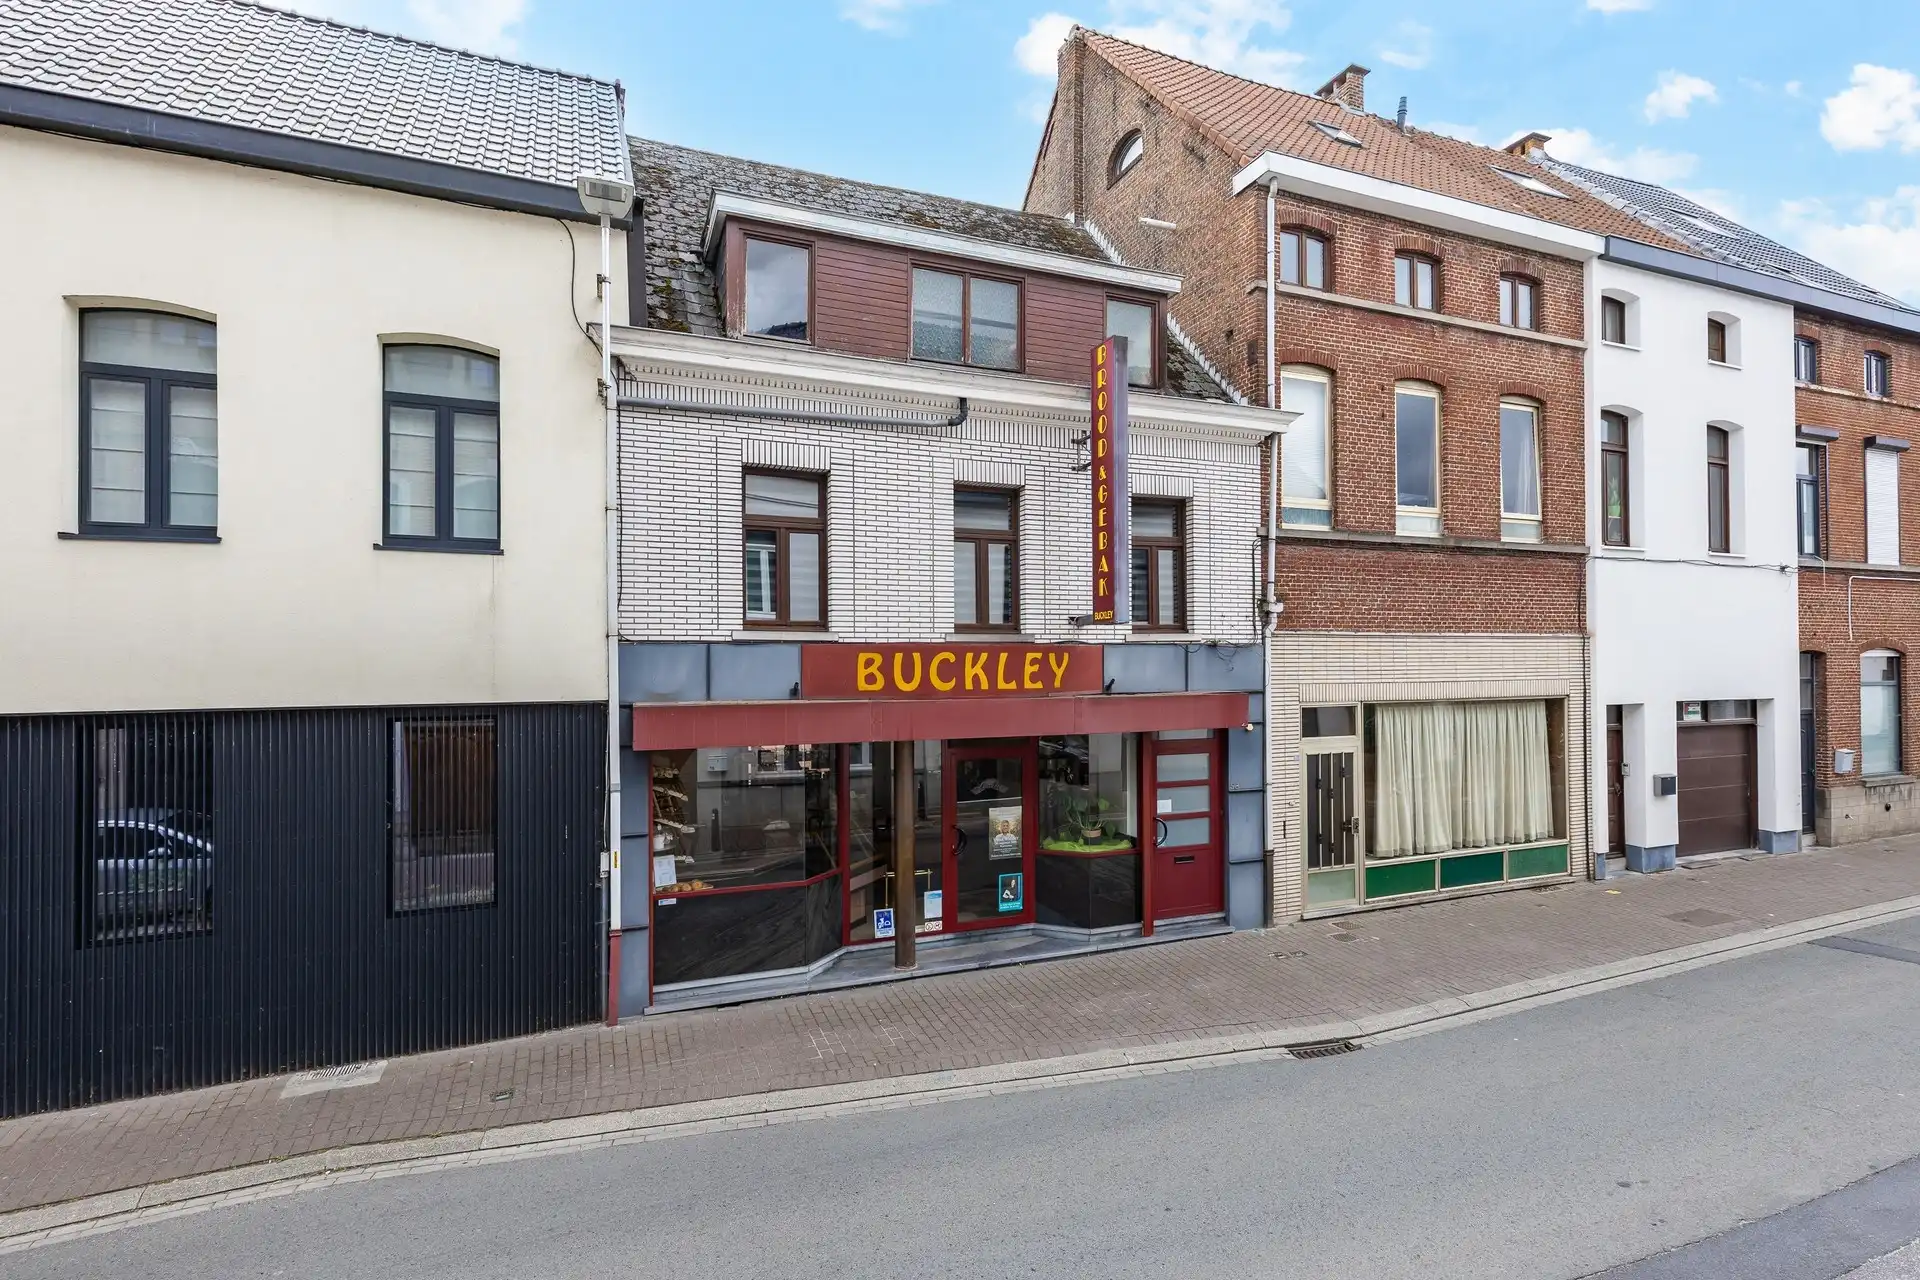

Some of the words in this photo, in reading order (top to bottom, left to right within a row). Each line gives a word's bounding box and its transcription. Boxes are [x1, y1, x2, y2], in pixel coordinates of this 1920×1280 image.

[1097, 344, 1107, 458] BROOD
[1098, 465, 1106, 480] &
[1098, 484, 1108, 597] GEBAK
[1094, 610, 1113, 620] BUCKLEY
[857, 651, 1070, 692] BUCKLEY
